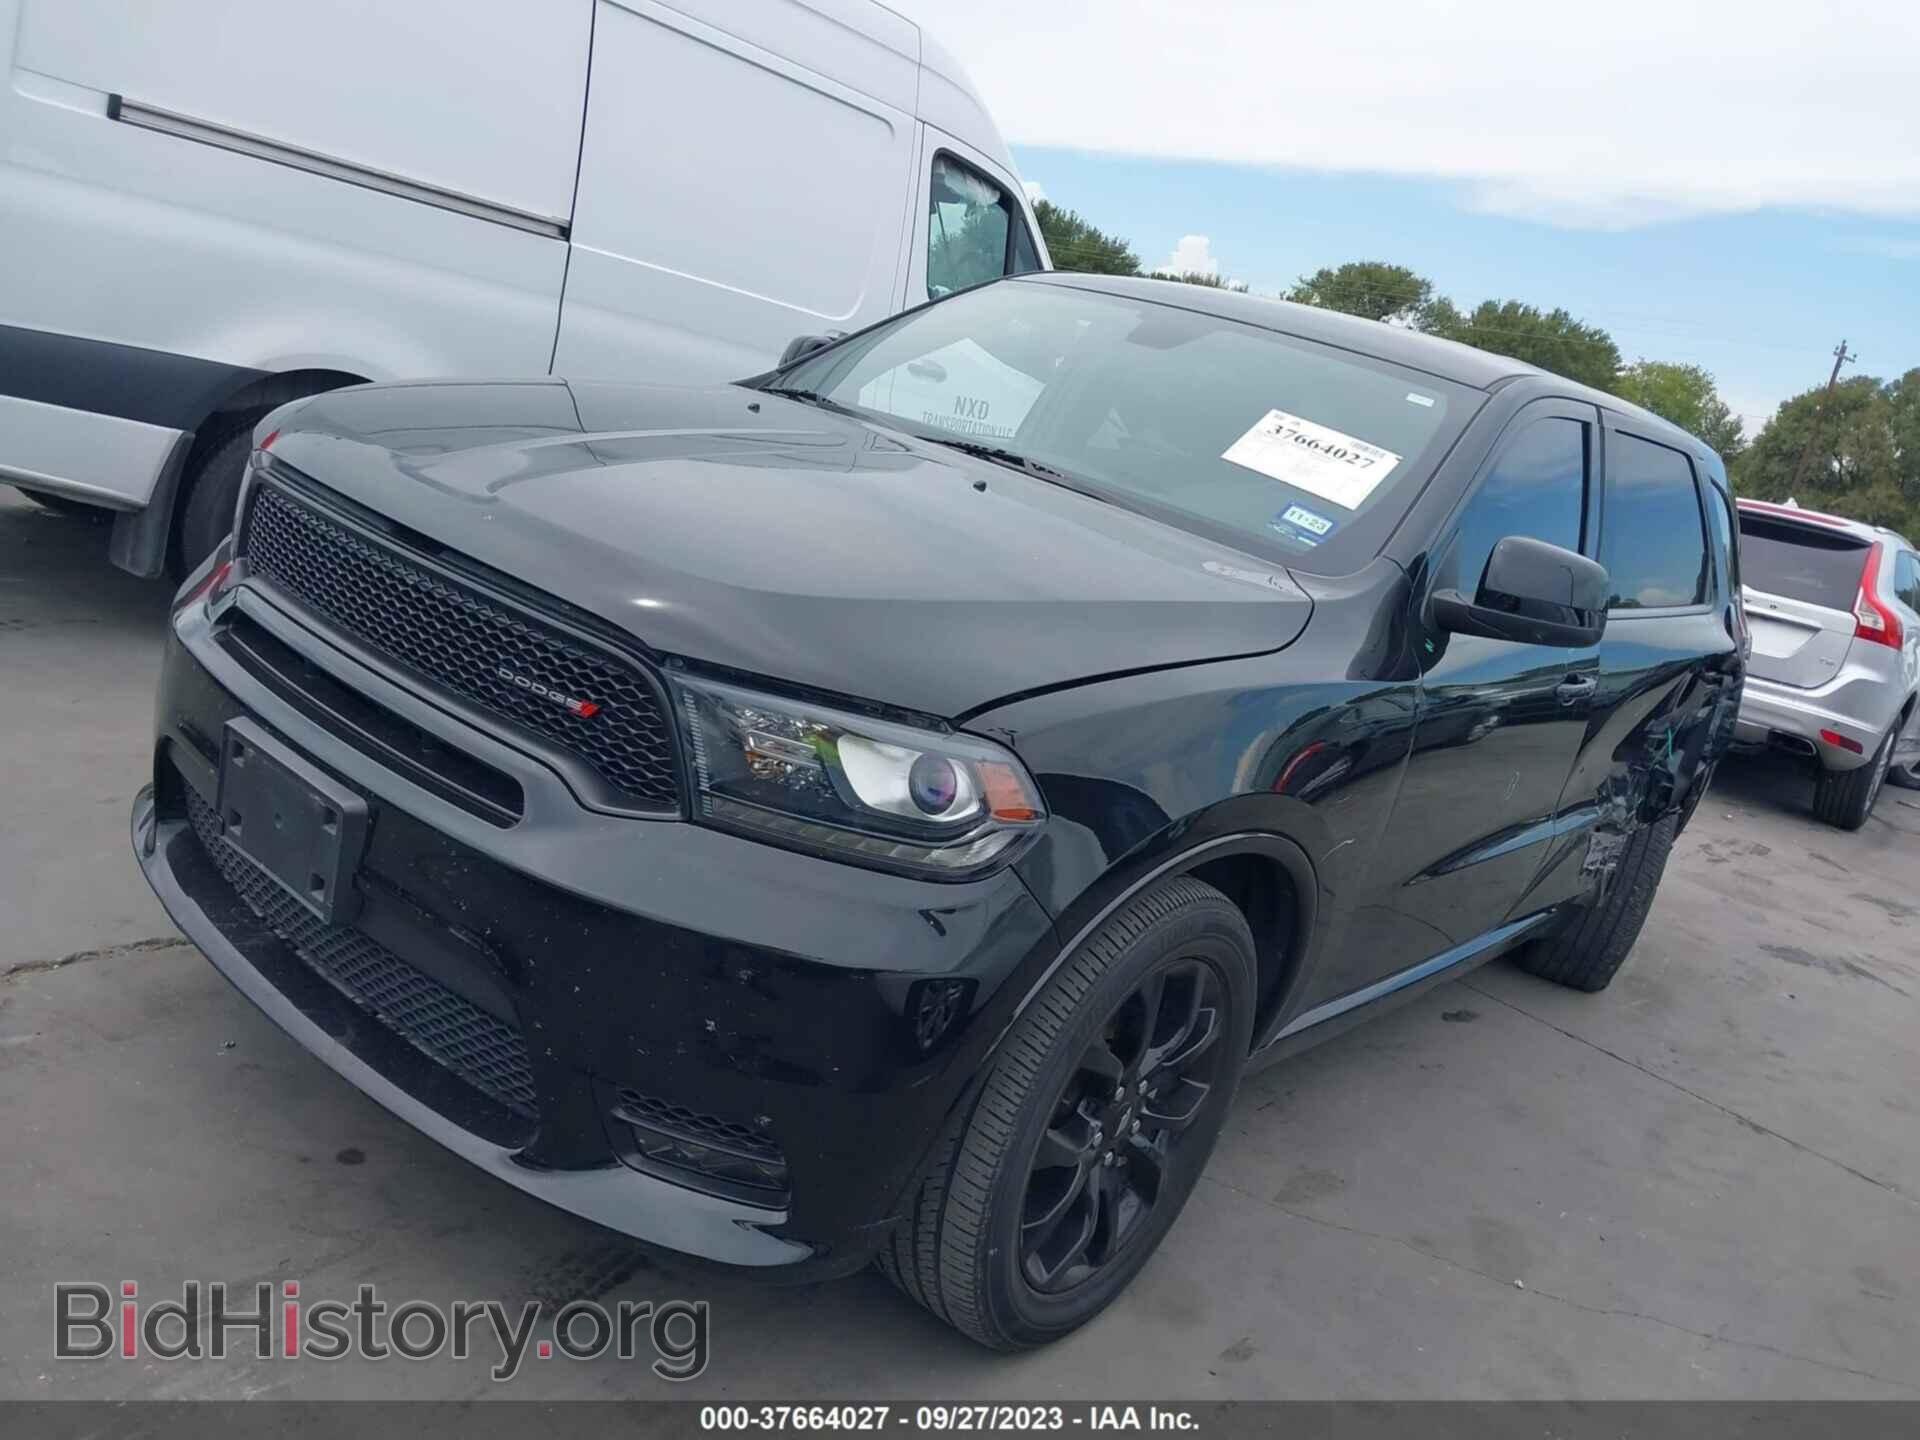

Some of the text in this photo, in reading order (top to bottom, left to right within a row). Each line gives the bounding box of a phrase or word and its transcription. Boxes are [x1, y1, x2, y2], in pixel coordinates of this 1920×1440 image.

[953, 395, 989, 420] NXD
[1267, 424, 1376, 468] 37664027
[498, 667, 582, 711] DODGE
